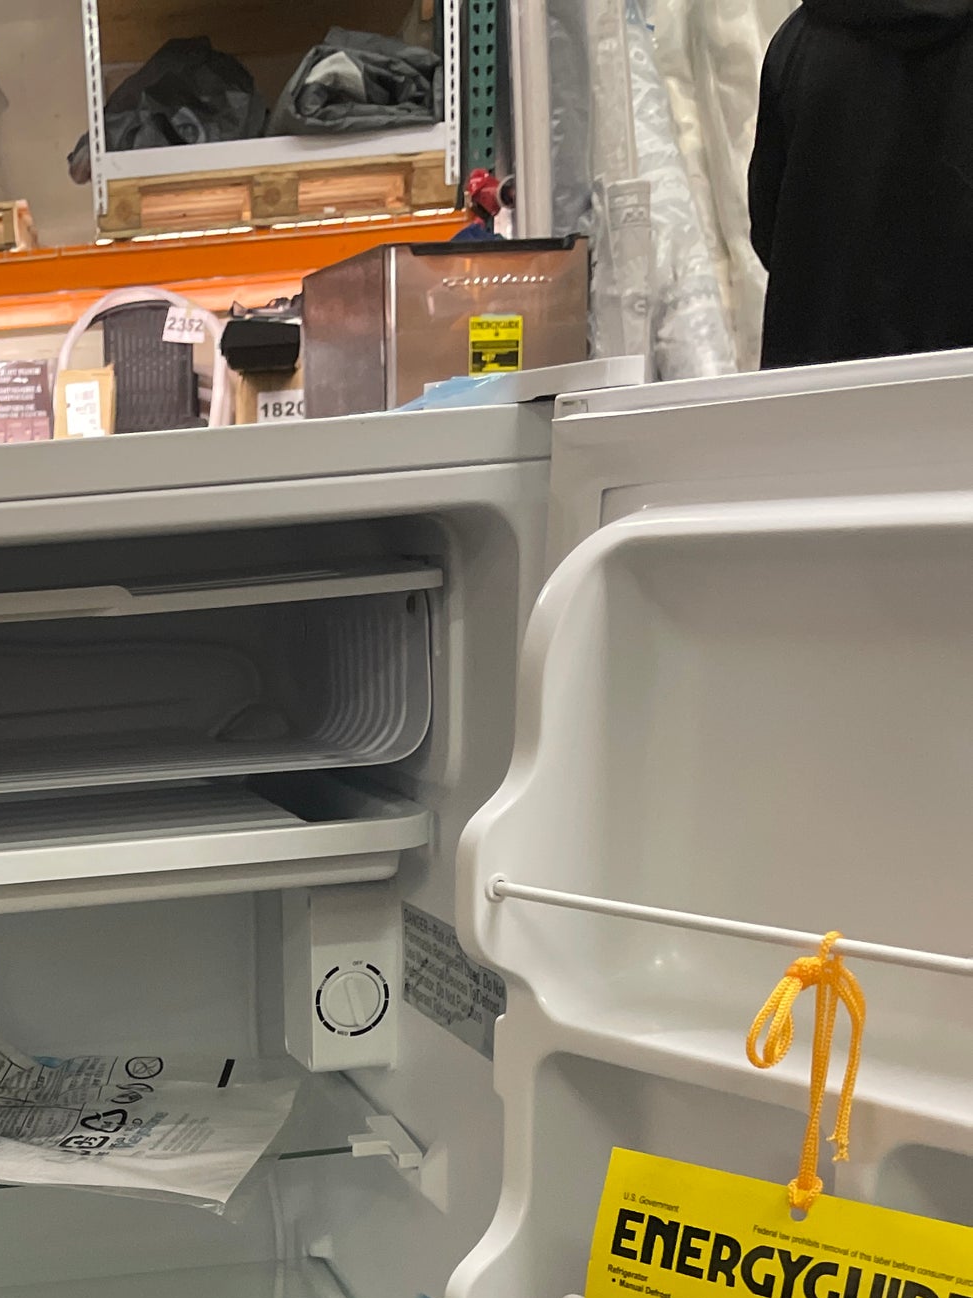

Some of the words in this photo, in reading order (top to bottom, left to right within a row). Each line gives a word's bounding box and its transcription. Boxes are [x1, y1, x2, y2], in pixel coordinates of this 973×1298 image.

[167, 316, 204, 332] 2352
[624, 1192, 636, 1202] U.S.
[639, 1195, 679, 1212] Government
[753, 1225, 778, 1238] Federal
[791, 1234, 820, 1249] prohibits
[821, 1242, 849, 1257] removal
[850, 1250, 859, 1259] of
[859, 1251, 872, 1263] this
[873, 1255, 891, 1267] label
[892, 1259, 917, 1274] before
[917, 1267, 955, 1282] consumer
[607, 1264, 649, 1282] Refrigerator
[619, 1279, 644, 1293] Manual
